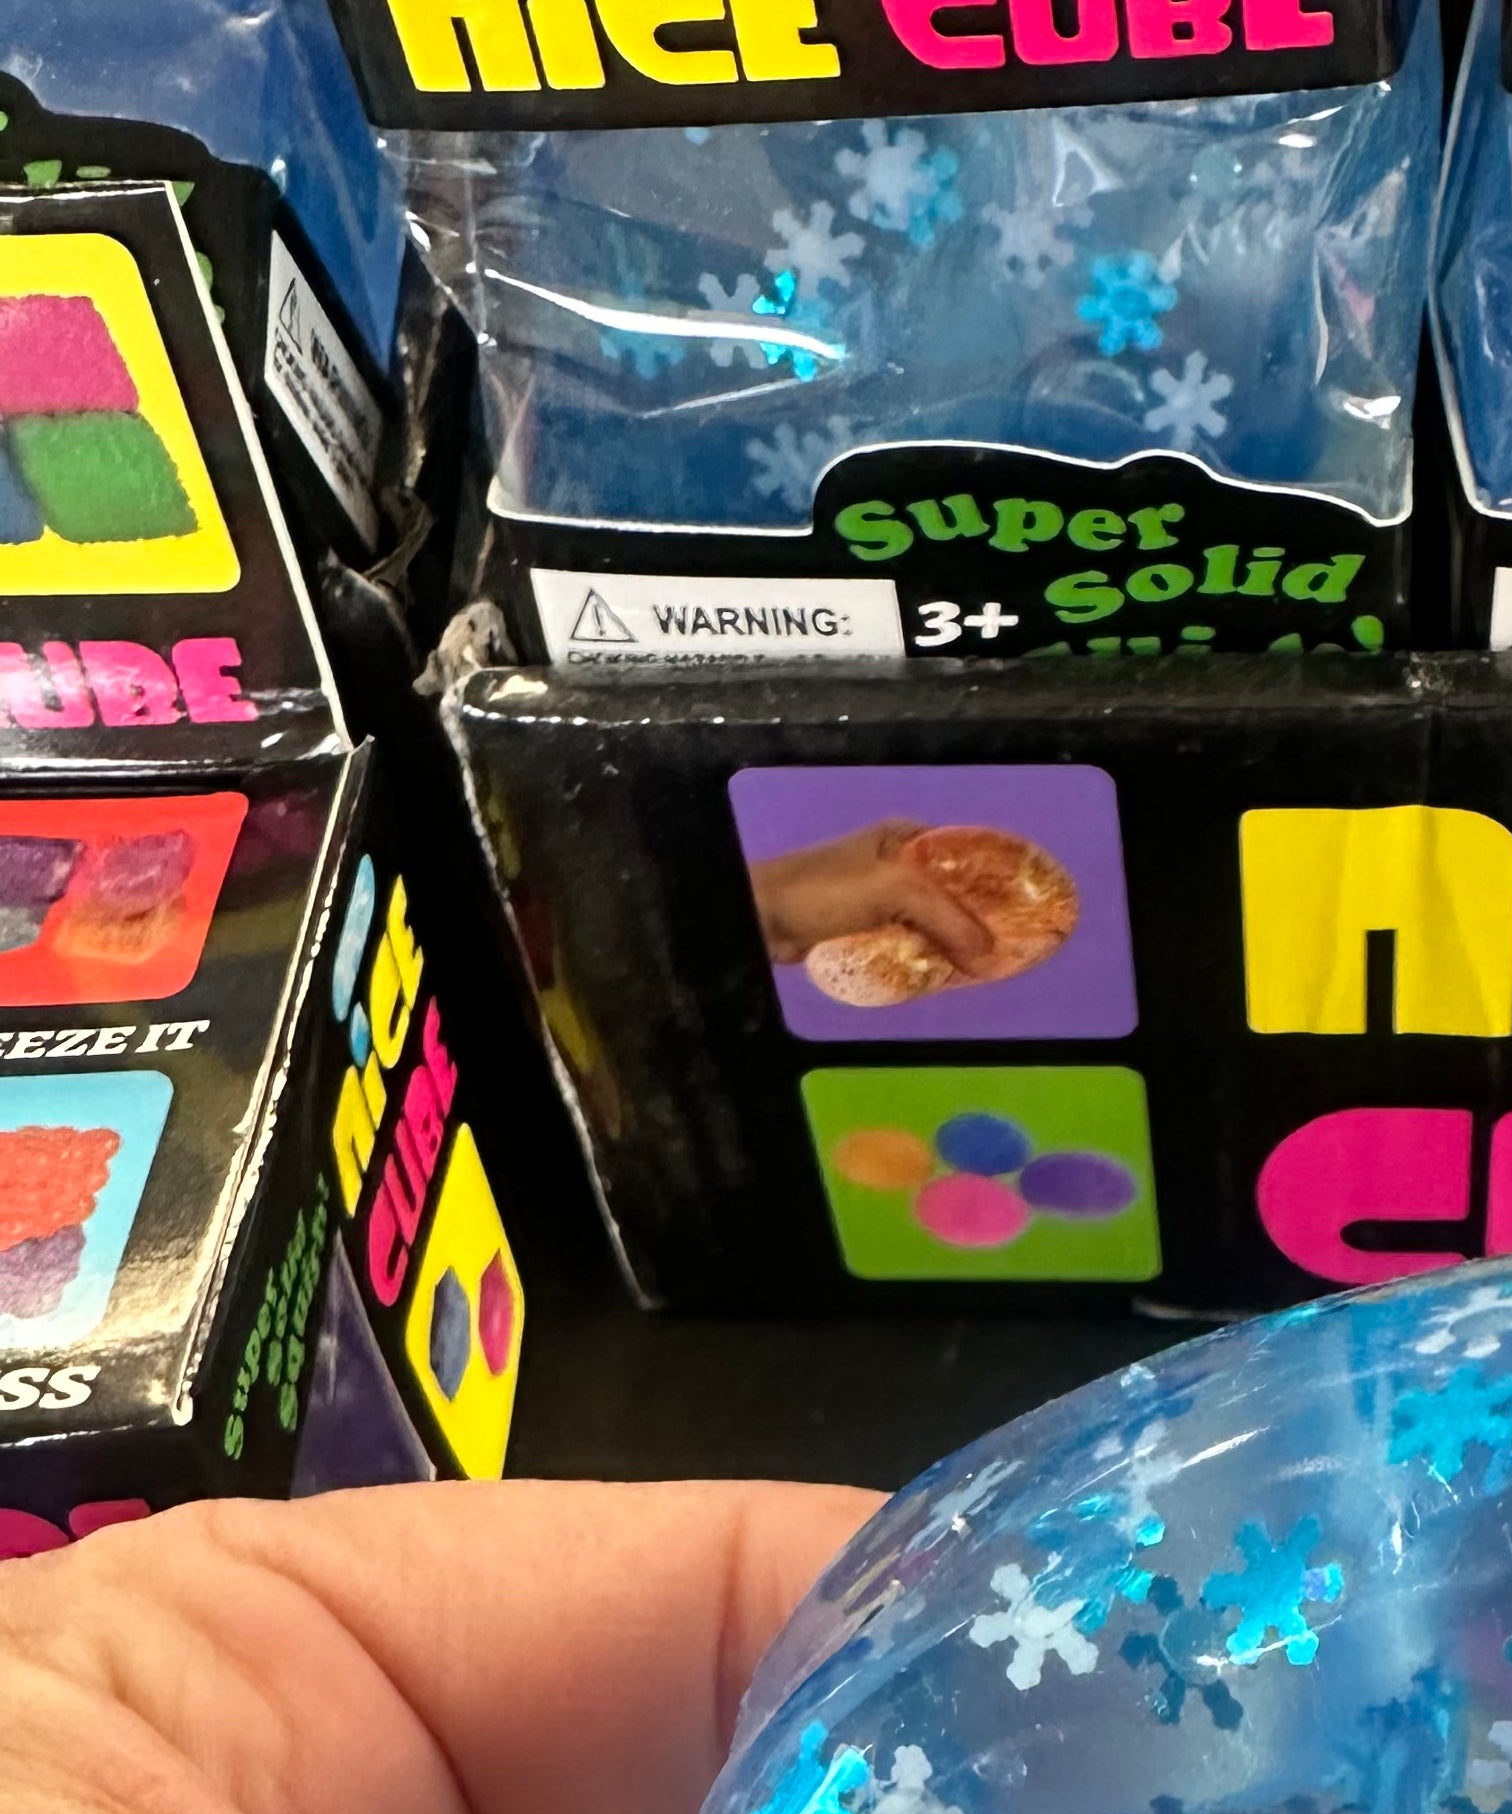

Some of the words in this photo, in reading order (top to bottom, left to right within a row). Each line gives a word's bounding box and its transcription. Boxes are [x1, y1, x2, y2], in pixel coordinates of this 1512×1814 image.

[834, 493, 1185, 562] Super
[1044, 543, 1366, 624] Solid
[652, 603, 855, 638] WARNING:
[913, 600, 1019, 647] 3+
[0, 636, 260, 730] UBE
[135, 1019, 211, 1054] IT
[369, 995, 458, 1307] CUBE
[0, 1364, 102, 1412] SS
